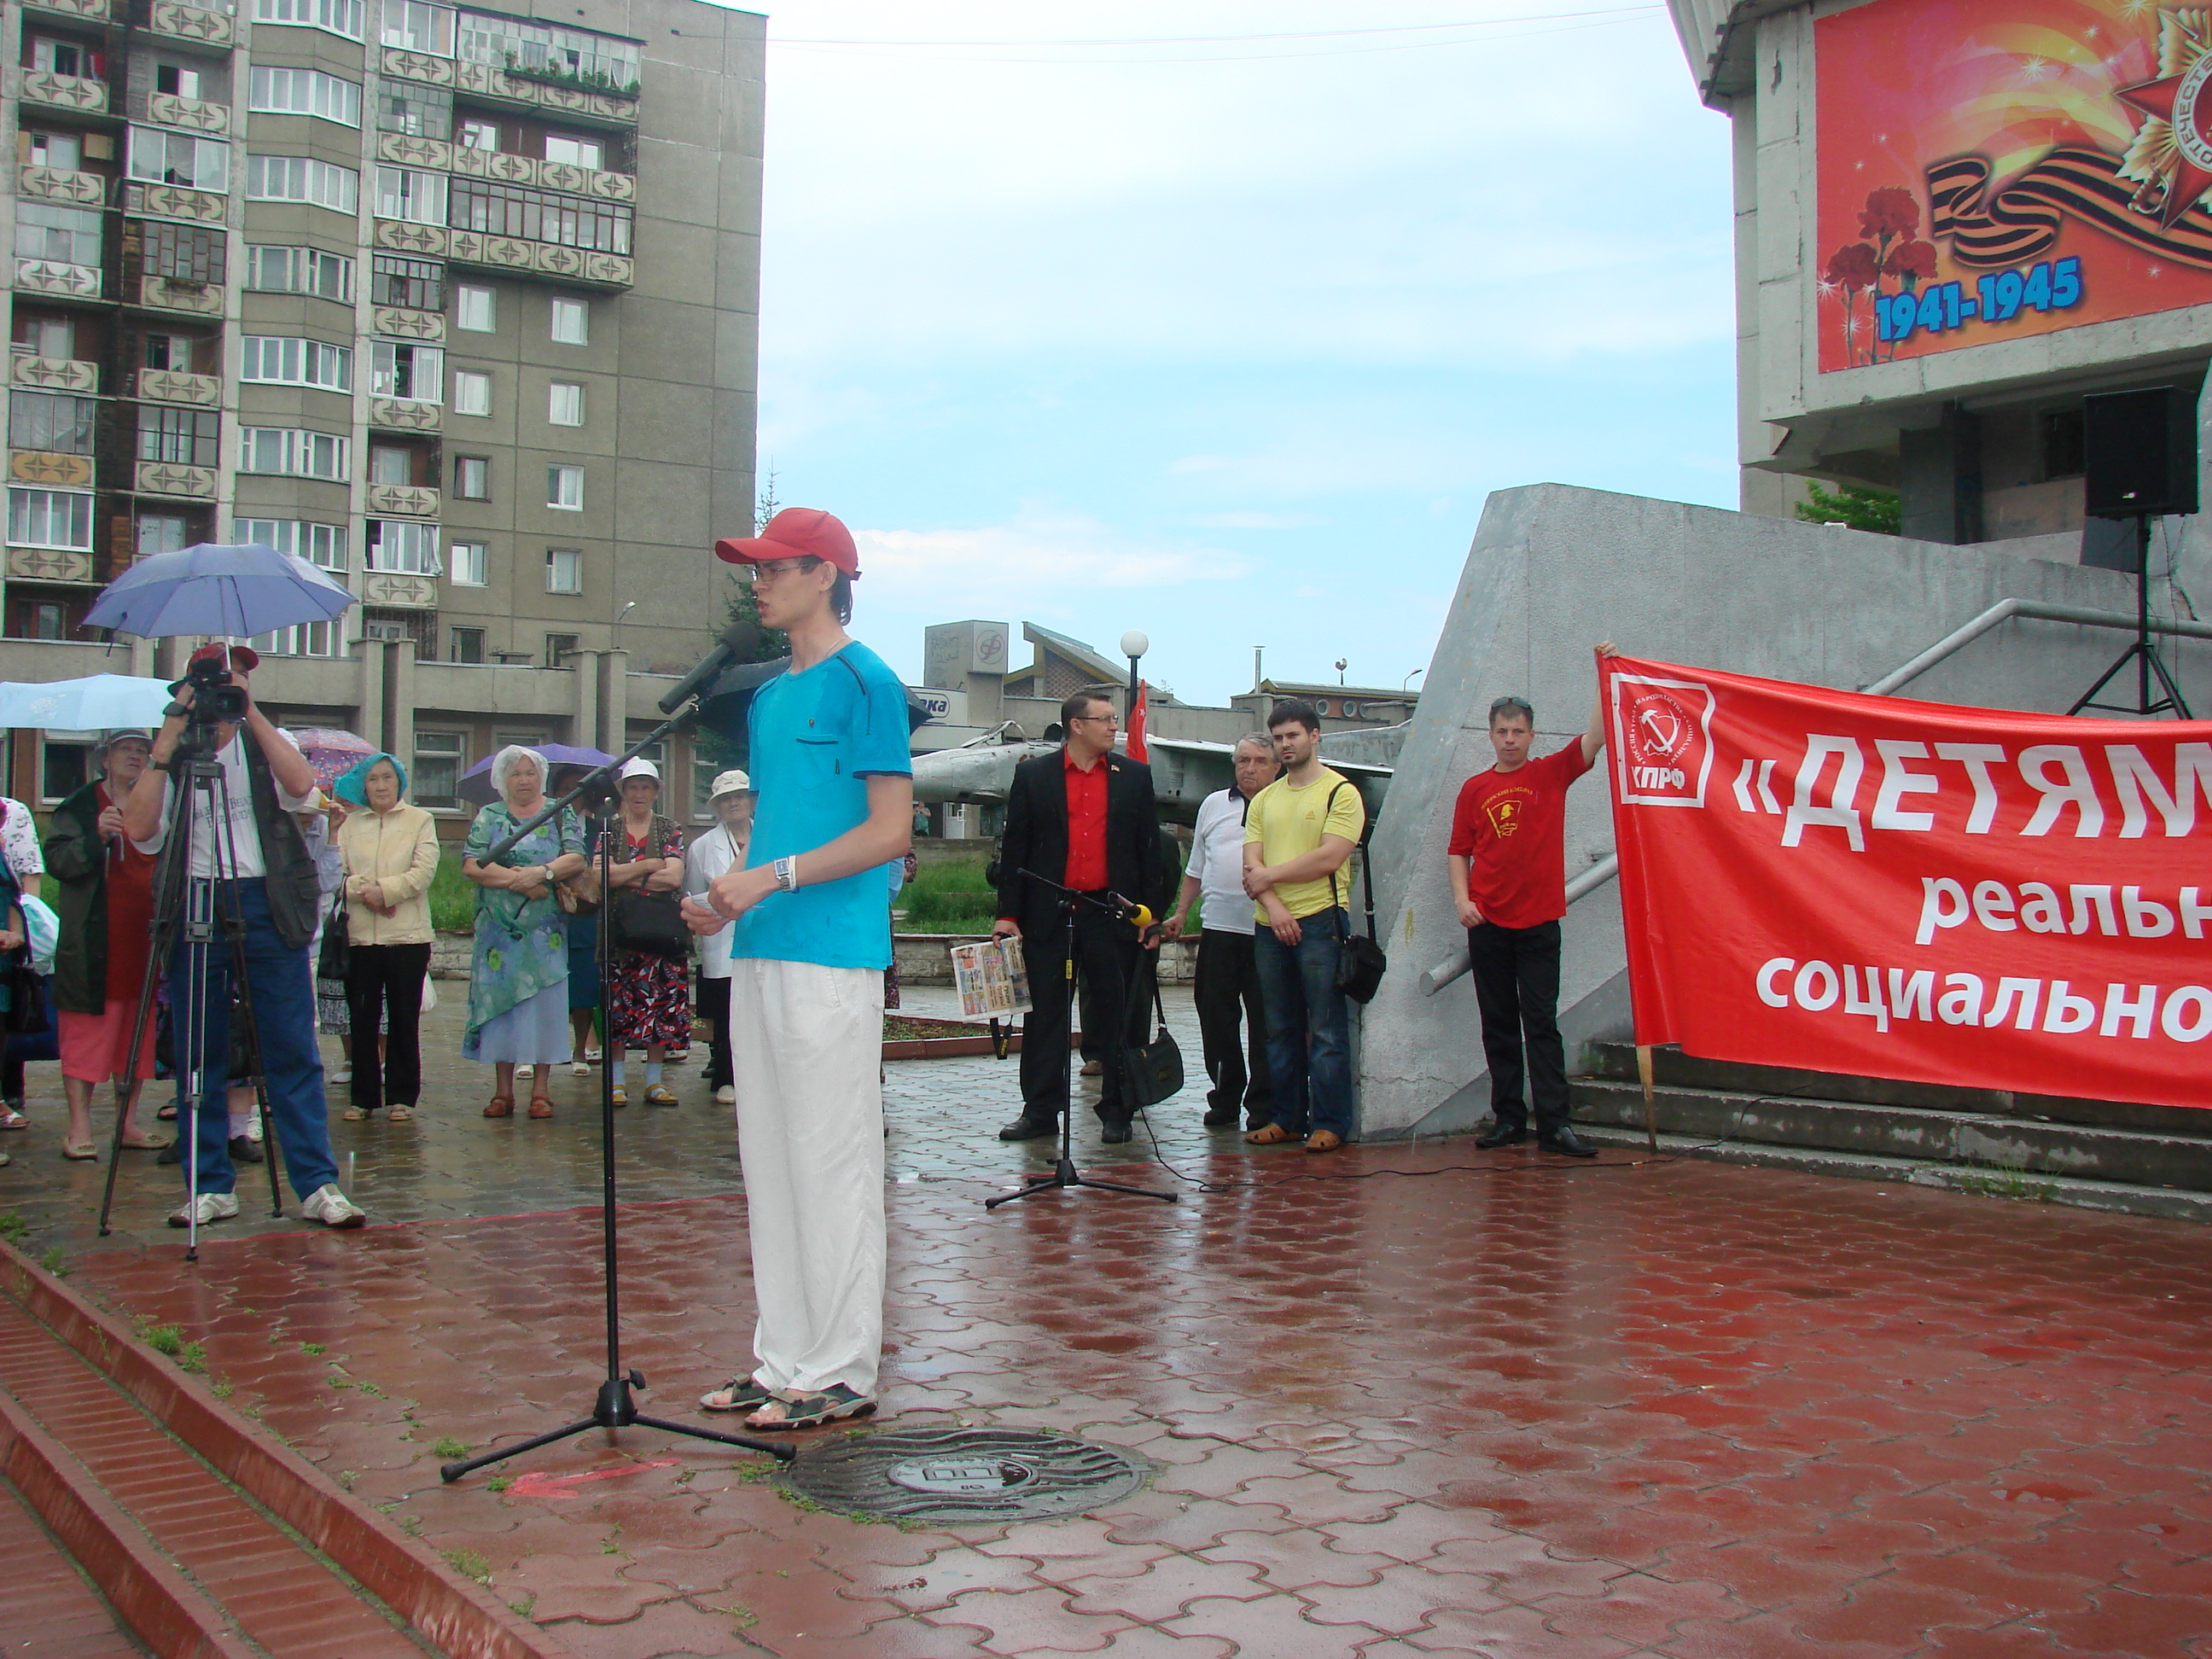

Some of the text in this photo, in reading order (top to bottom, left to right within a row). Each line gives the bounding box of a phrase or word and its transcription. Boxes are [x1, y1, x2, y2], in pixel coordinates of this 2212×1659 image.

[1874, 257, 2081, 341] 1941-1945
[1632, 765, 1686, 790] КПРФ
[1914, 876, 2212, 946] реальн
[1755, 957, 2212, 1043] социально
